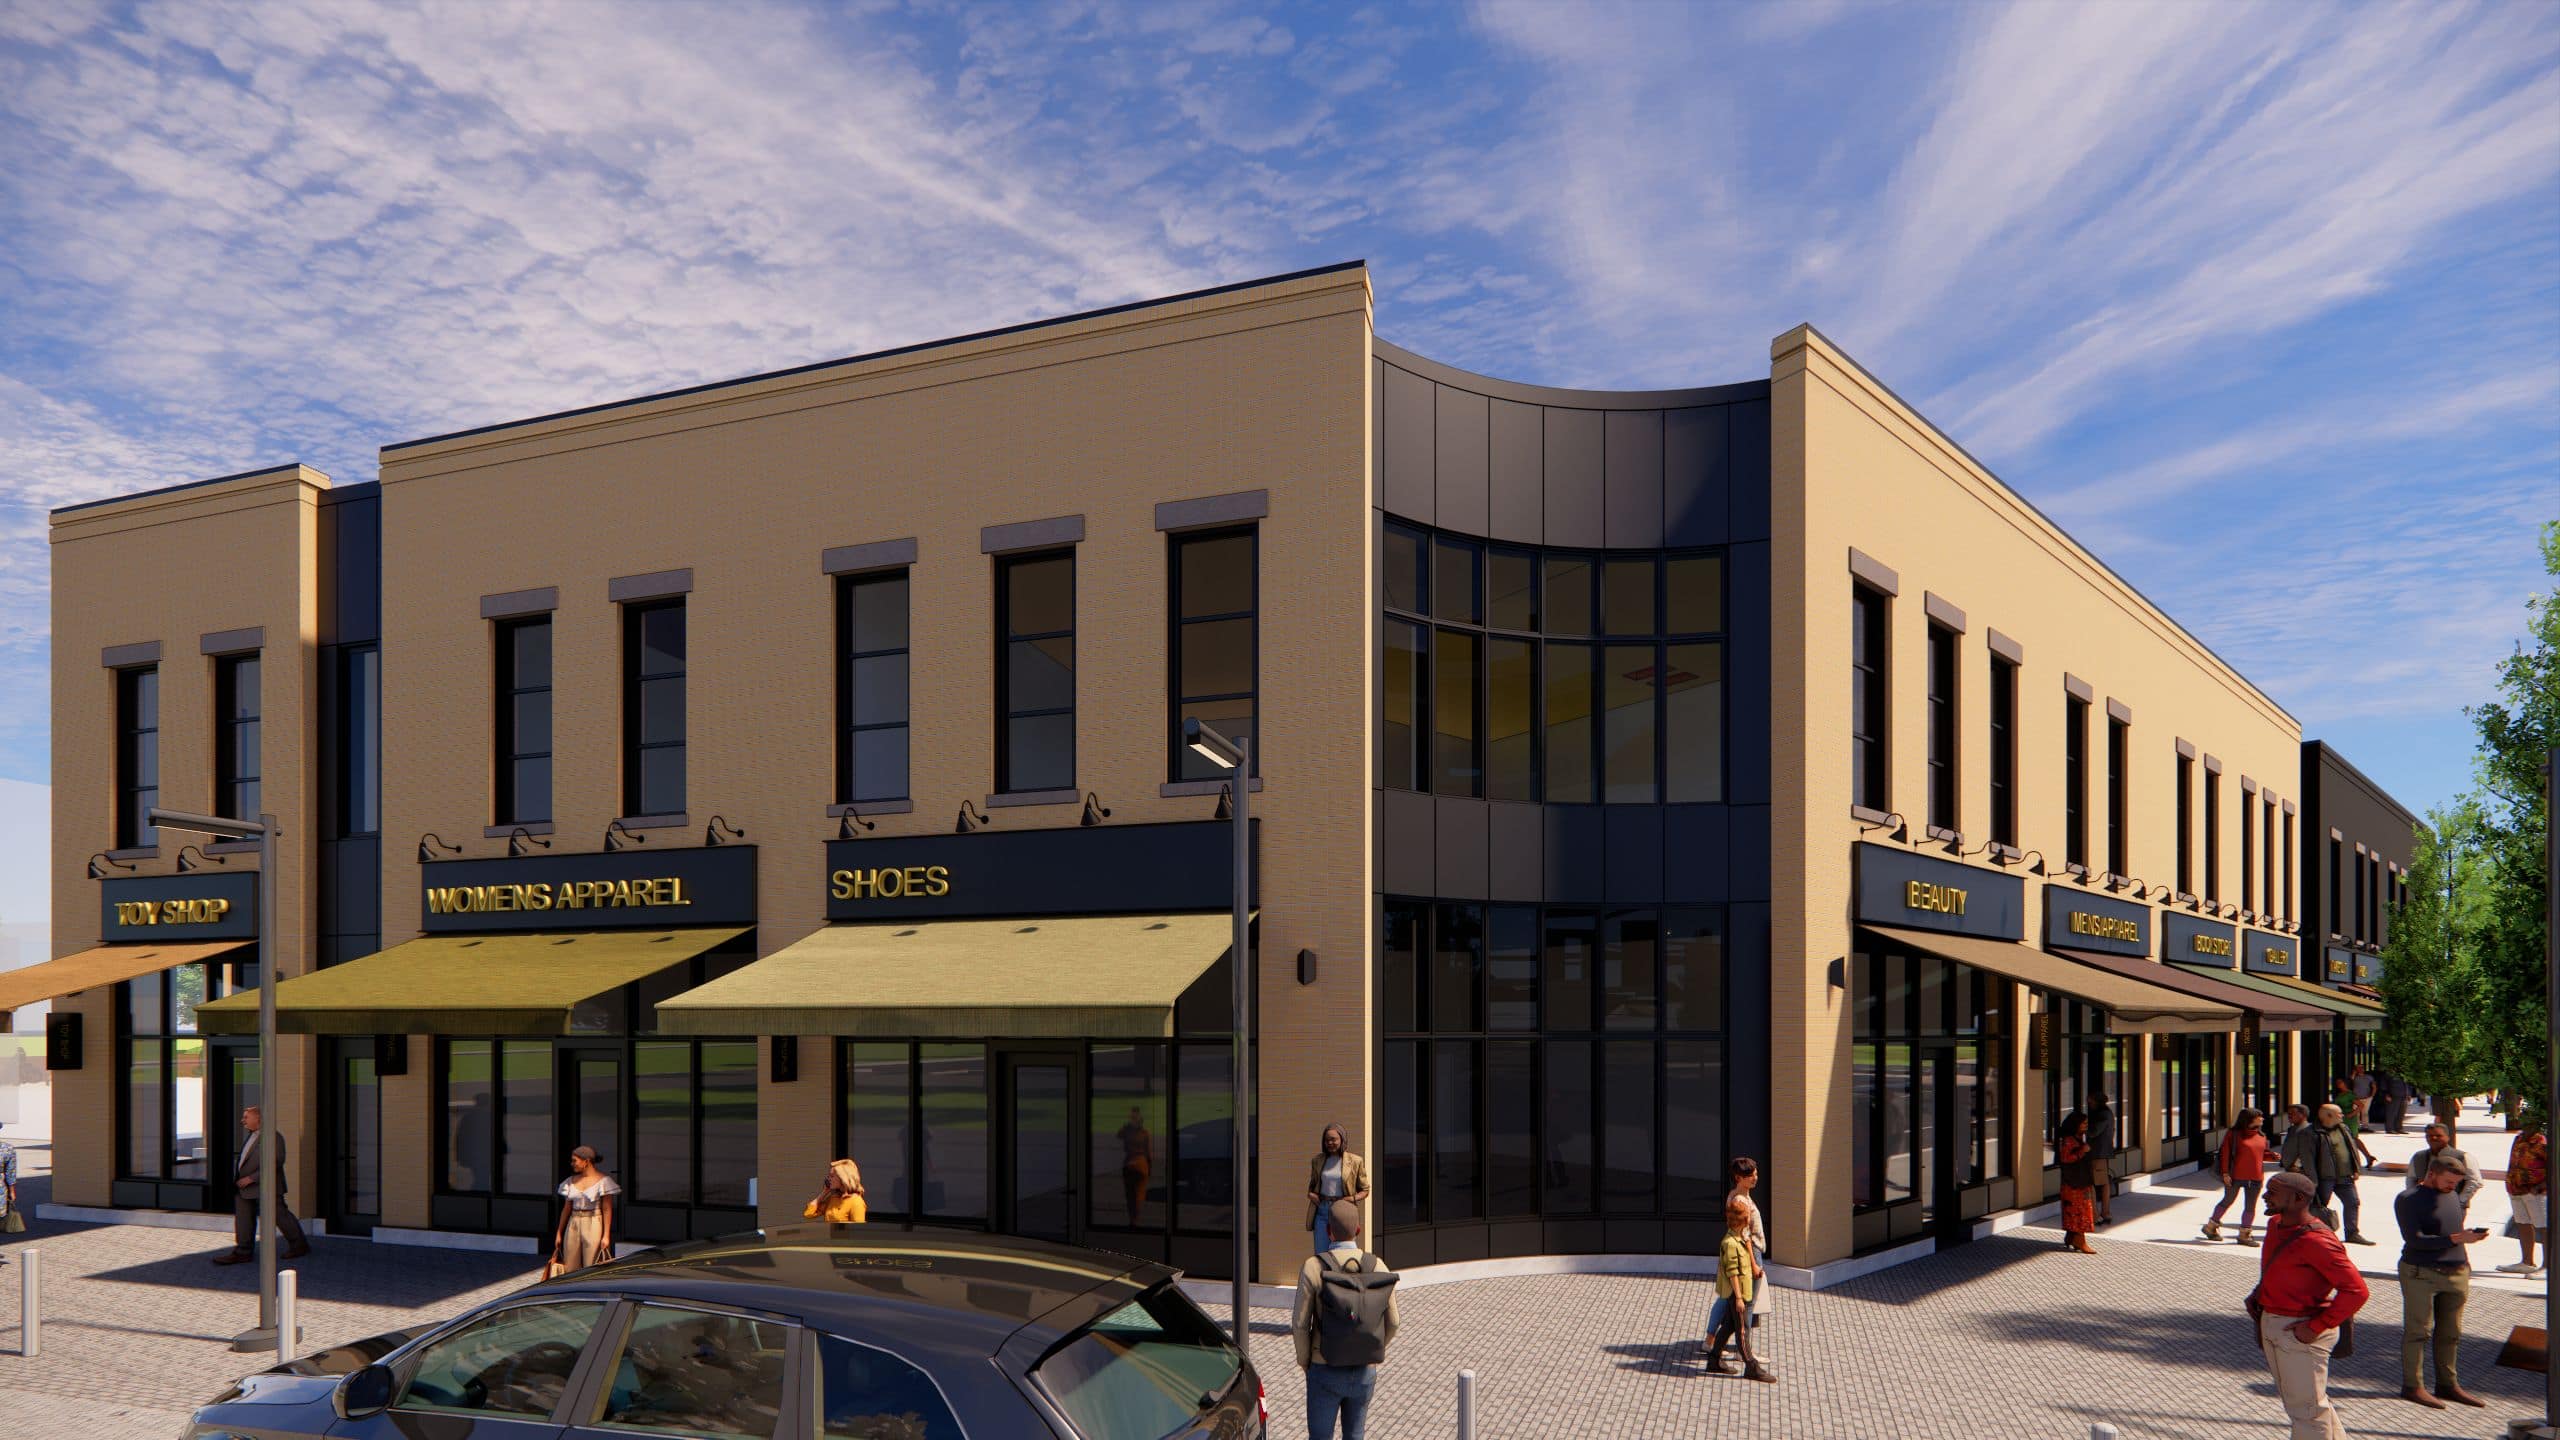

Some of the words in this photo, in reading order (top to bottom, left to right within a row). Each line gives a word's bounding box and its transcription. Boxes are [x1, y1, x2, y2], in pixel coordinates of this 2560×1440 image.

[426, 883, 552, 913] WOMENS
[556, 877, 691, 909] APPAREL
[832, 865, 949, 899] SHOES
[1906, 880, 1968, 915] BEAUTY
[114, 901, 162, 926] TOY
[163, 898, 230, 924] SHOP
[2070, 911, 2100, 937] MENS
[2101, 916, 2140, 942] APPAREL
